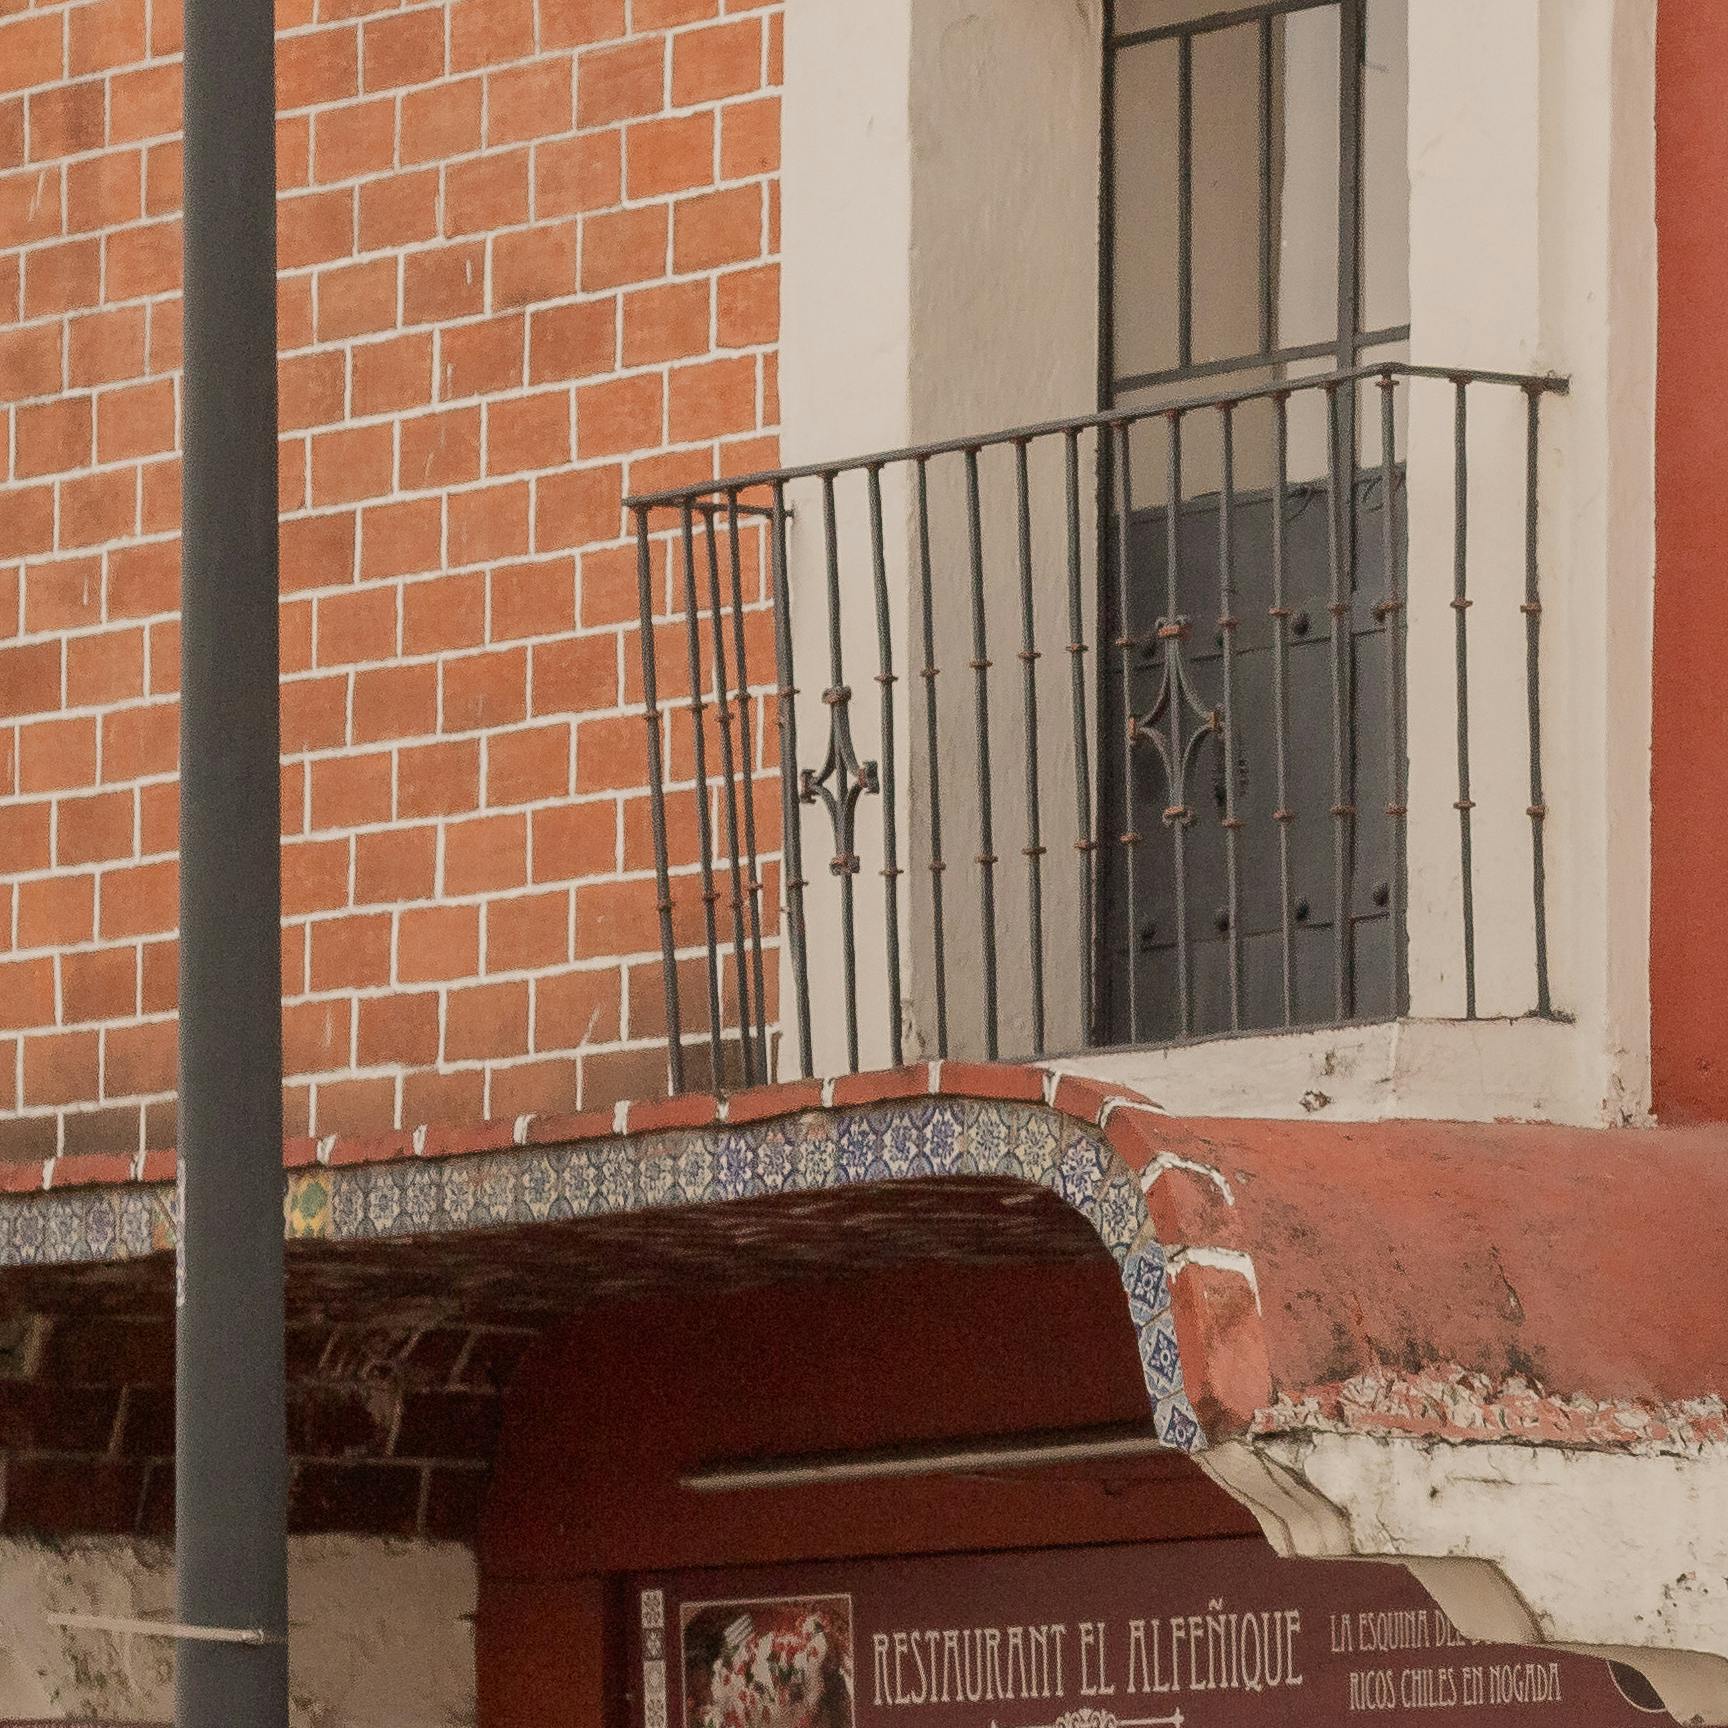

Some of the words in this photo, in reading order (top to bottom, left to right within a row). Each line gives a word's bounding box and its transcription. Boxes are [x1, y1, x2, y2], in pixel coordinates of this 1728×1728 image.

[873, 1623, 1068, 1706] RESTAURANT
[1079, 1622, 1116, 1696] EL
[1126, 1598, 1303, 1694] ALFEÑIQUE
[1330, 1614, 1354, 1653] LA
[1359, 1609, 1429, 1650] ESQUINA
[1349, 1669, 1395, 1710] RICOS
[1400, 1667, 1456, 1708] CHILES
[1462, 1665, 1485, 1706] EN
[1489, 1662, 1563, 1704] NOGADA
